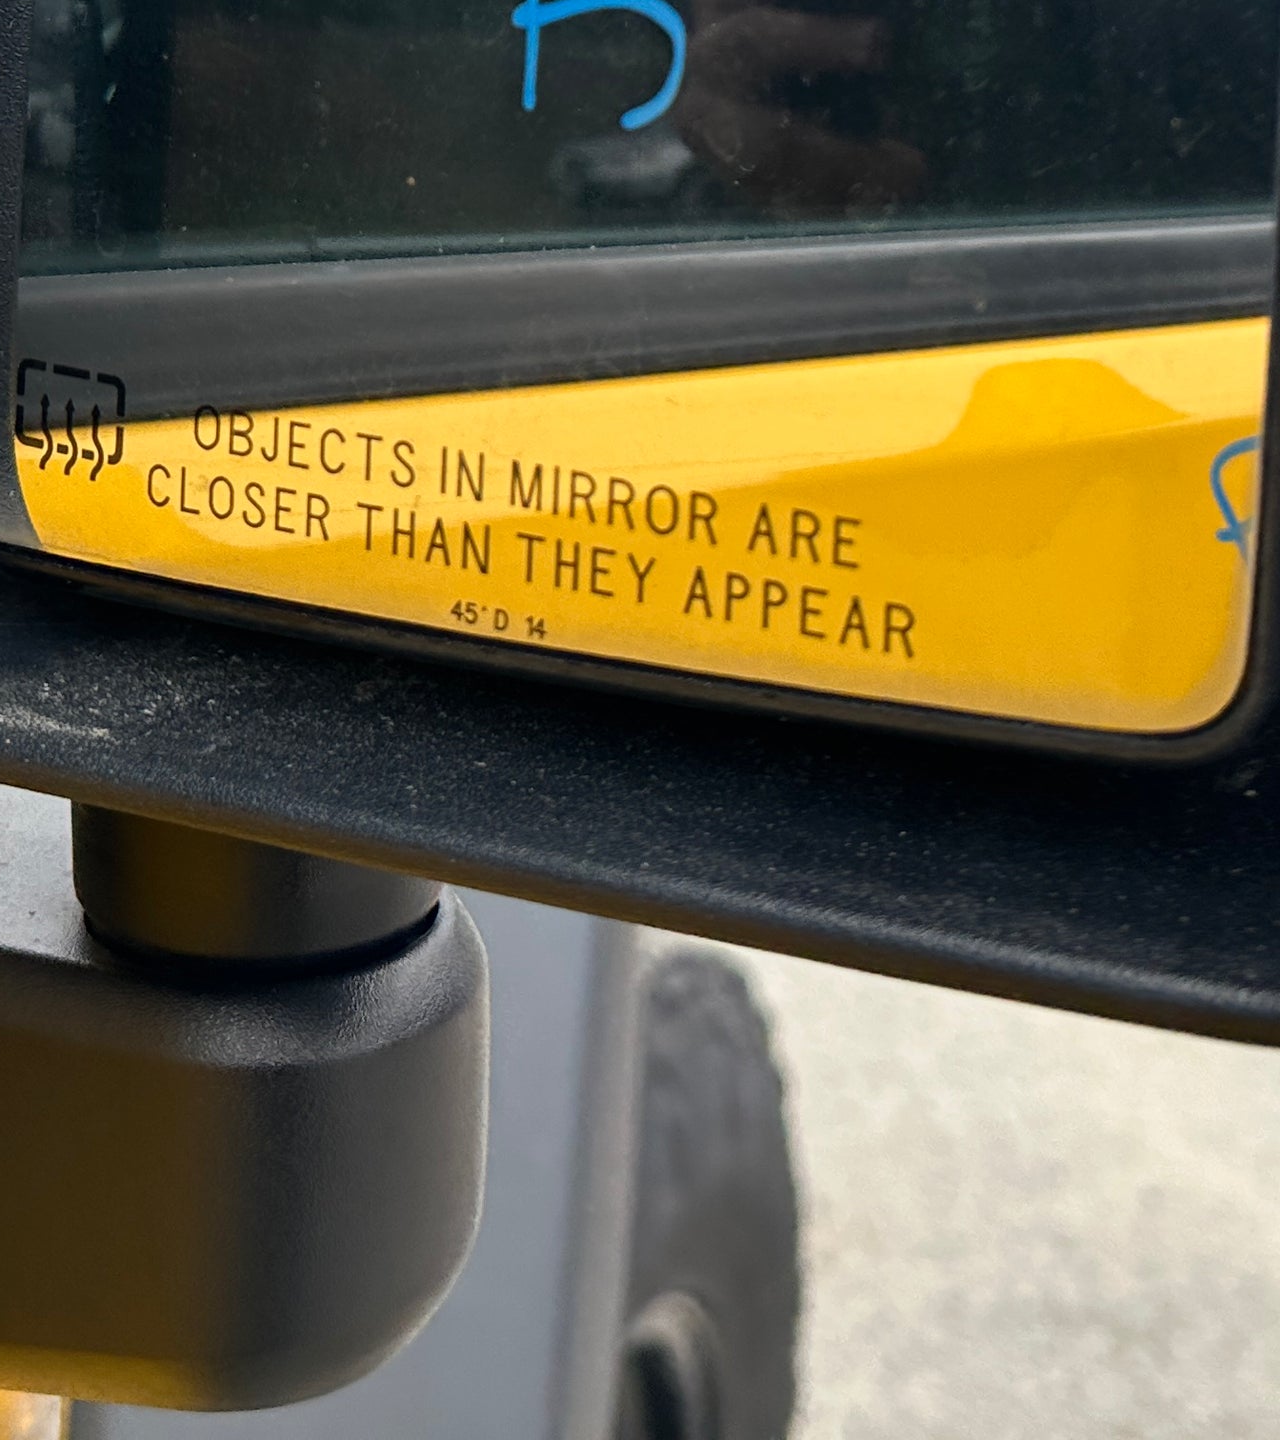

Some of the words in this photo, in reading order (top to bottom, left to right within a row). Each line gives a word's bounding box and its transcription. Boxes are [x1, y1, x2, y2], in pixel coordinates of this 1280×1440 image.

[146, 463, 331, 542] CLOSER
[355, 501, 493, 576] THAN
[515, 530, 658, 605] THEY
[682, 564, 917, 659] APPEAR
[194, 404, 416, 489] OBJECTS
[439, 445, 486, 503] IN
[509, 459, 719, 547] MIRROR
[747, 502, 863, 571] ARE
